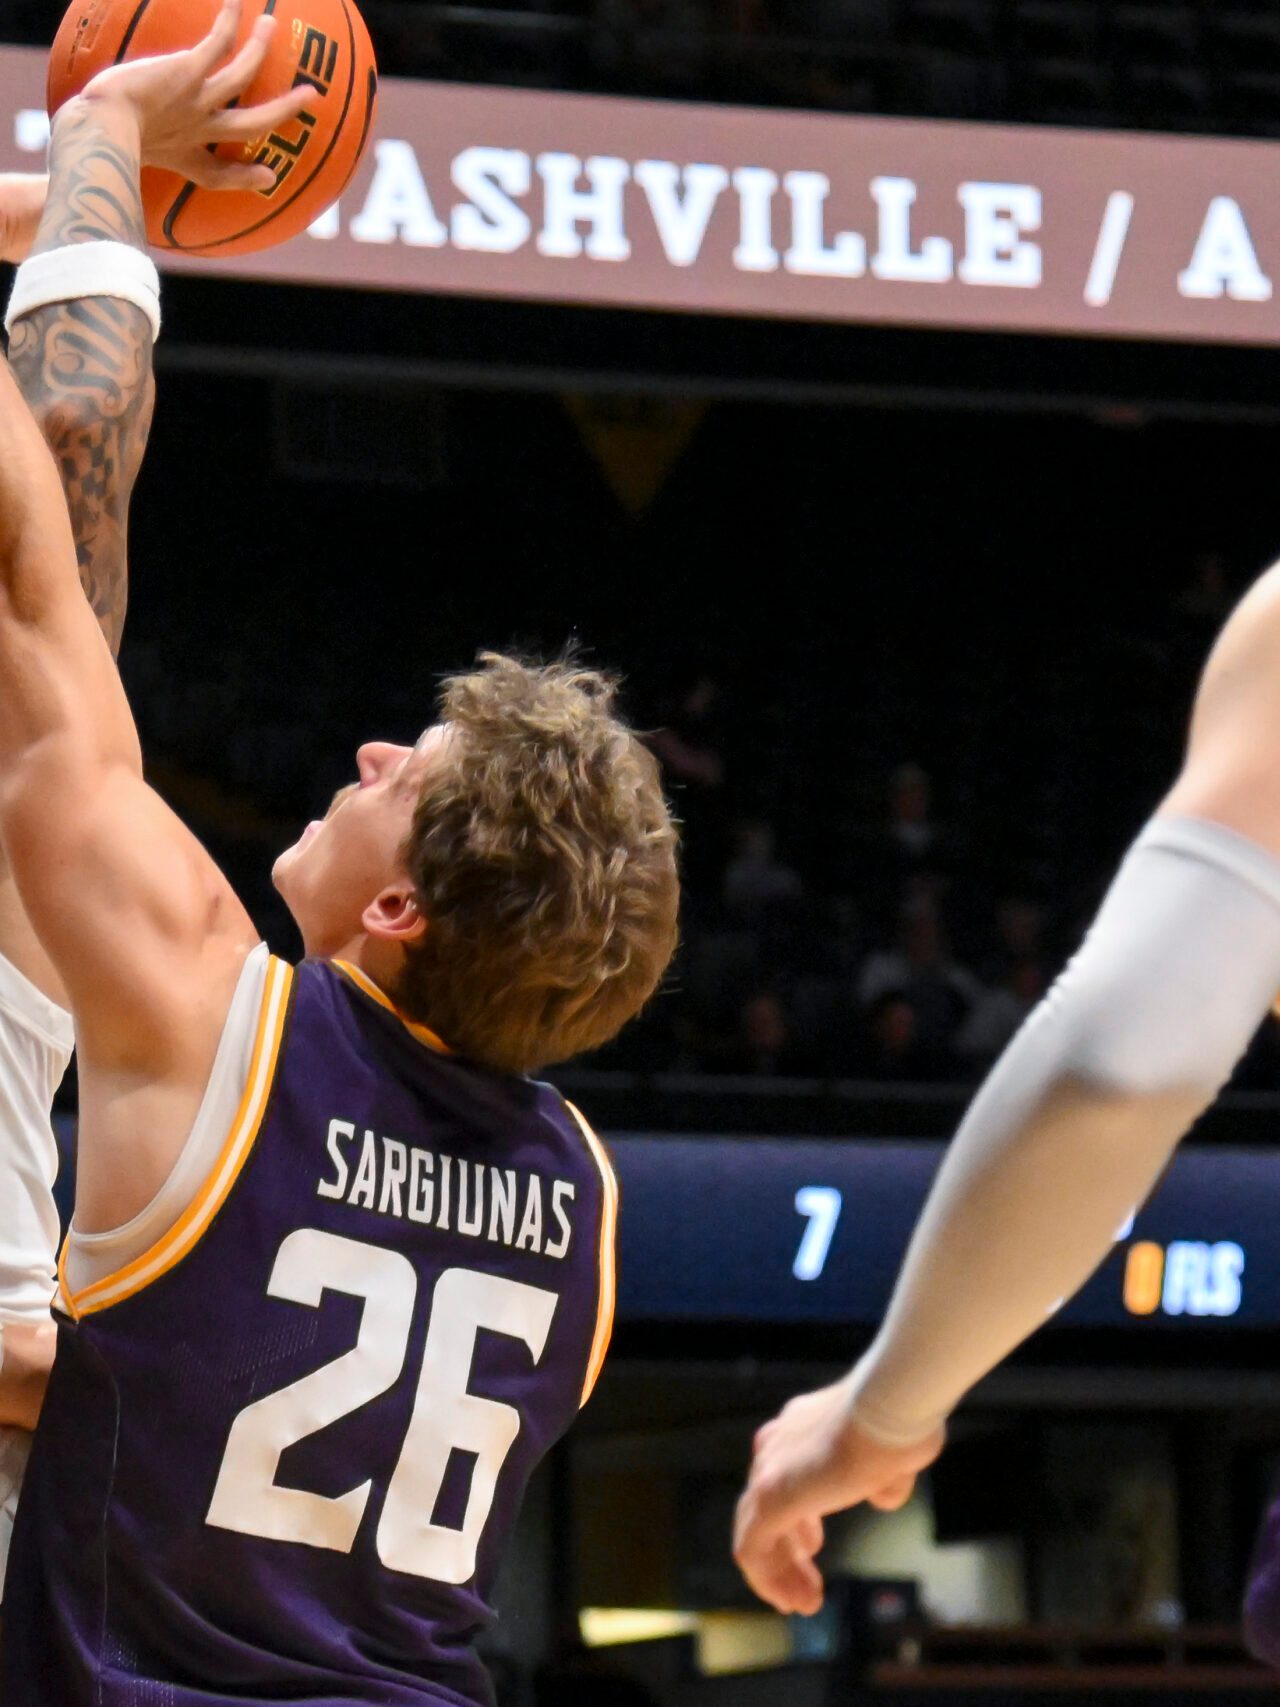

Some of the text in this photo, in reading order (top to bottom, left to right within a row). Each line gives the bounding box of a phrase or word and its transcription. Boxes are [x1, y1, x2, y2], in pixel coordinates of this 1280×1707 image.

[307, 139, 1042, 287] ASHVILLE
[317, 1118, 576, 1259] SARGIUNAS
[792, 1185, 843, 1282] 7
[205, 1227, 559, 1585] 26
